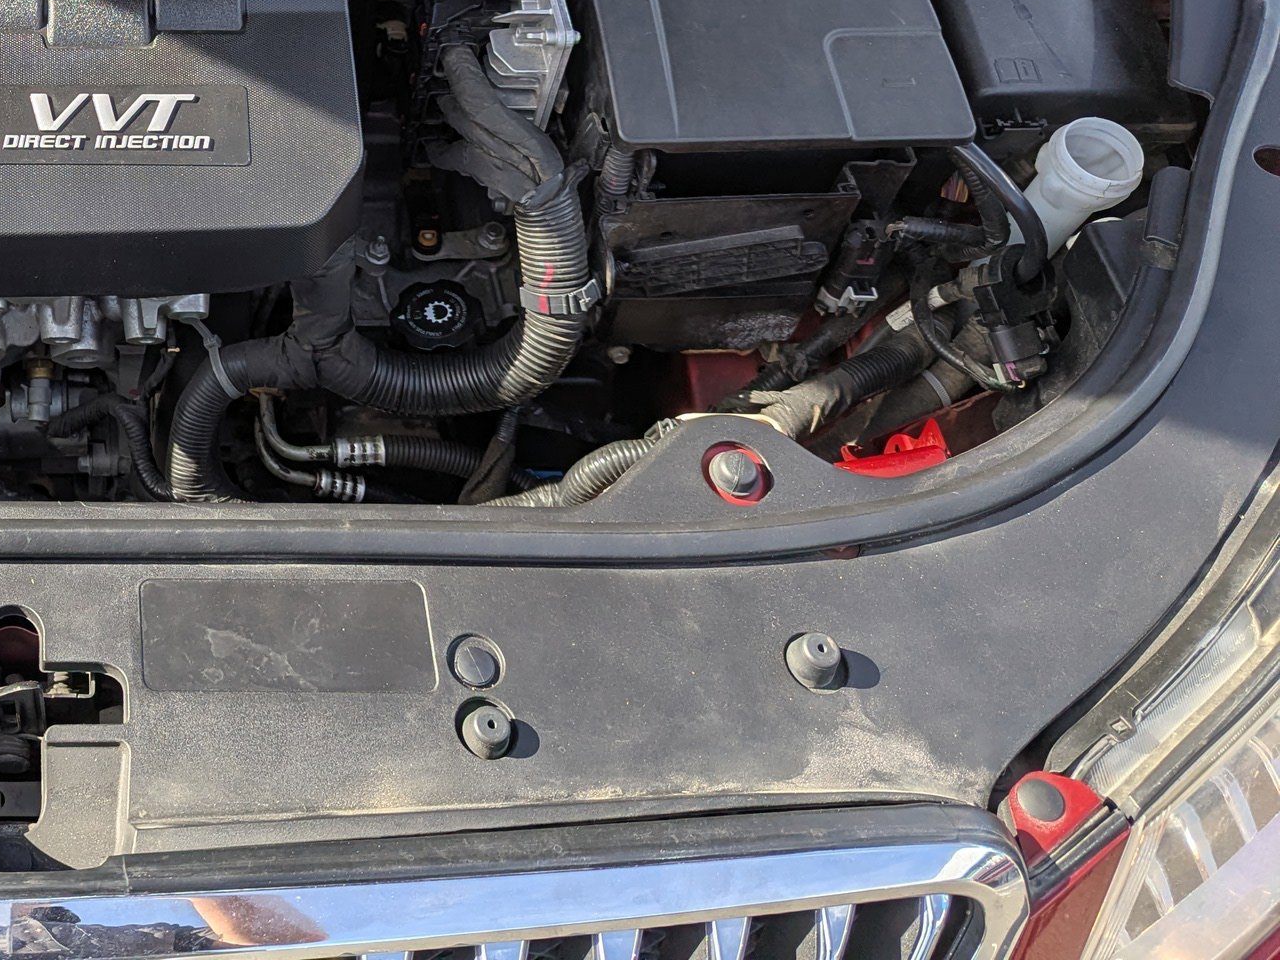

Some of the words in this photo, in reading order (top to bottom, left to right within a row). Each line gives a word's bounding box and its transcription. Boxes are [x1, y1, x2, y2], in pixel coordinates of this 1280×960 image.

[29, 93, 196, 133] VVT
[3, 134, 86, 150] DIRECT
[95, 134, 211, 150] INJECTION
